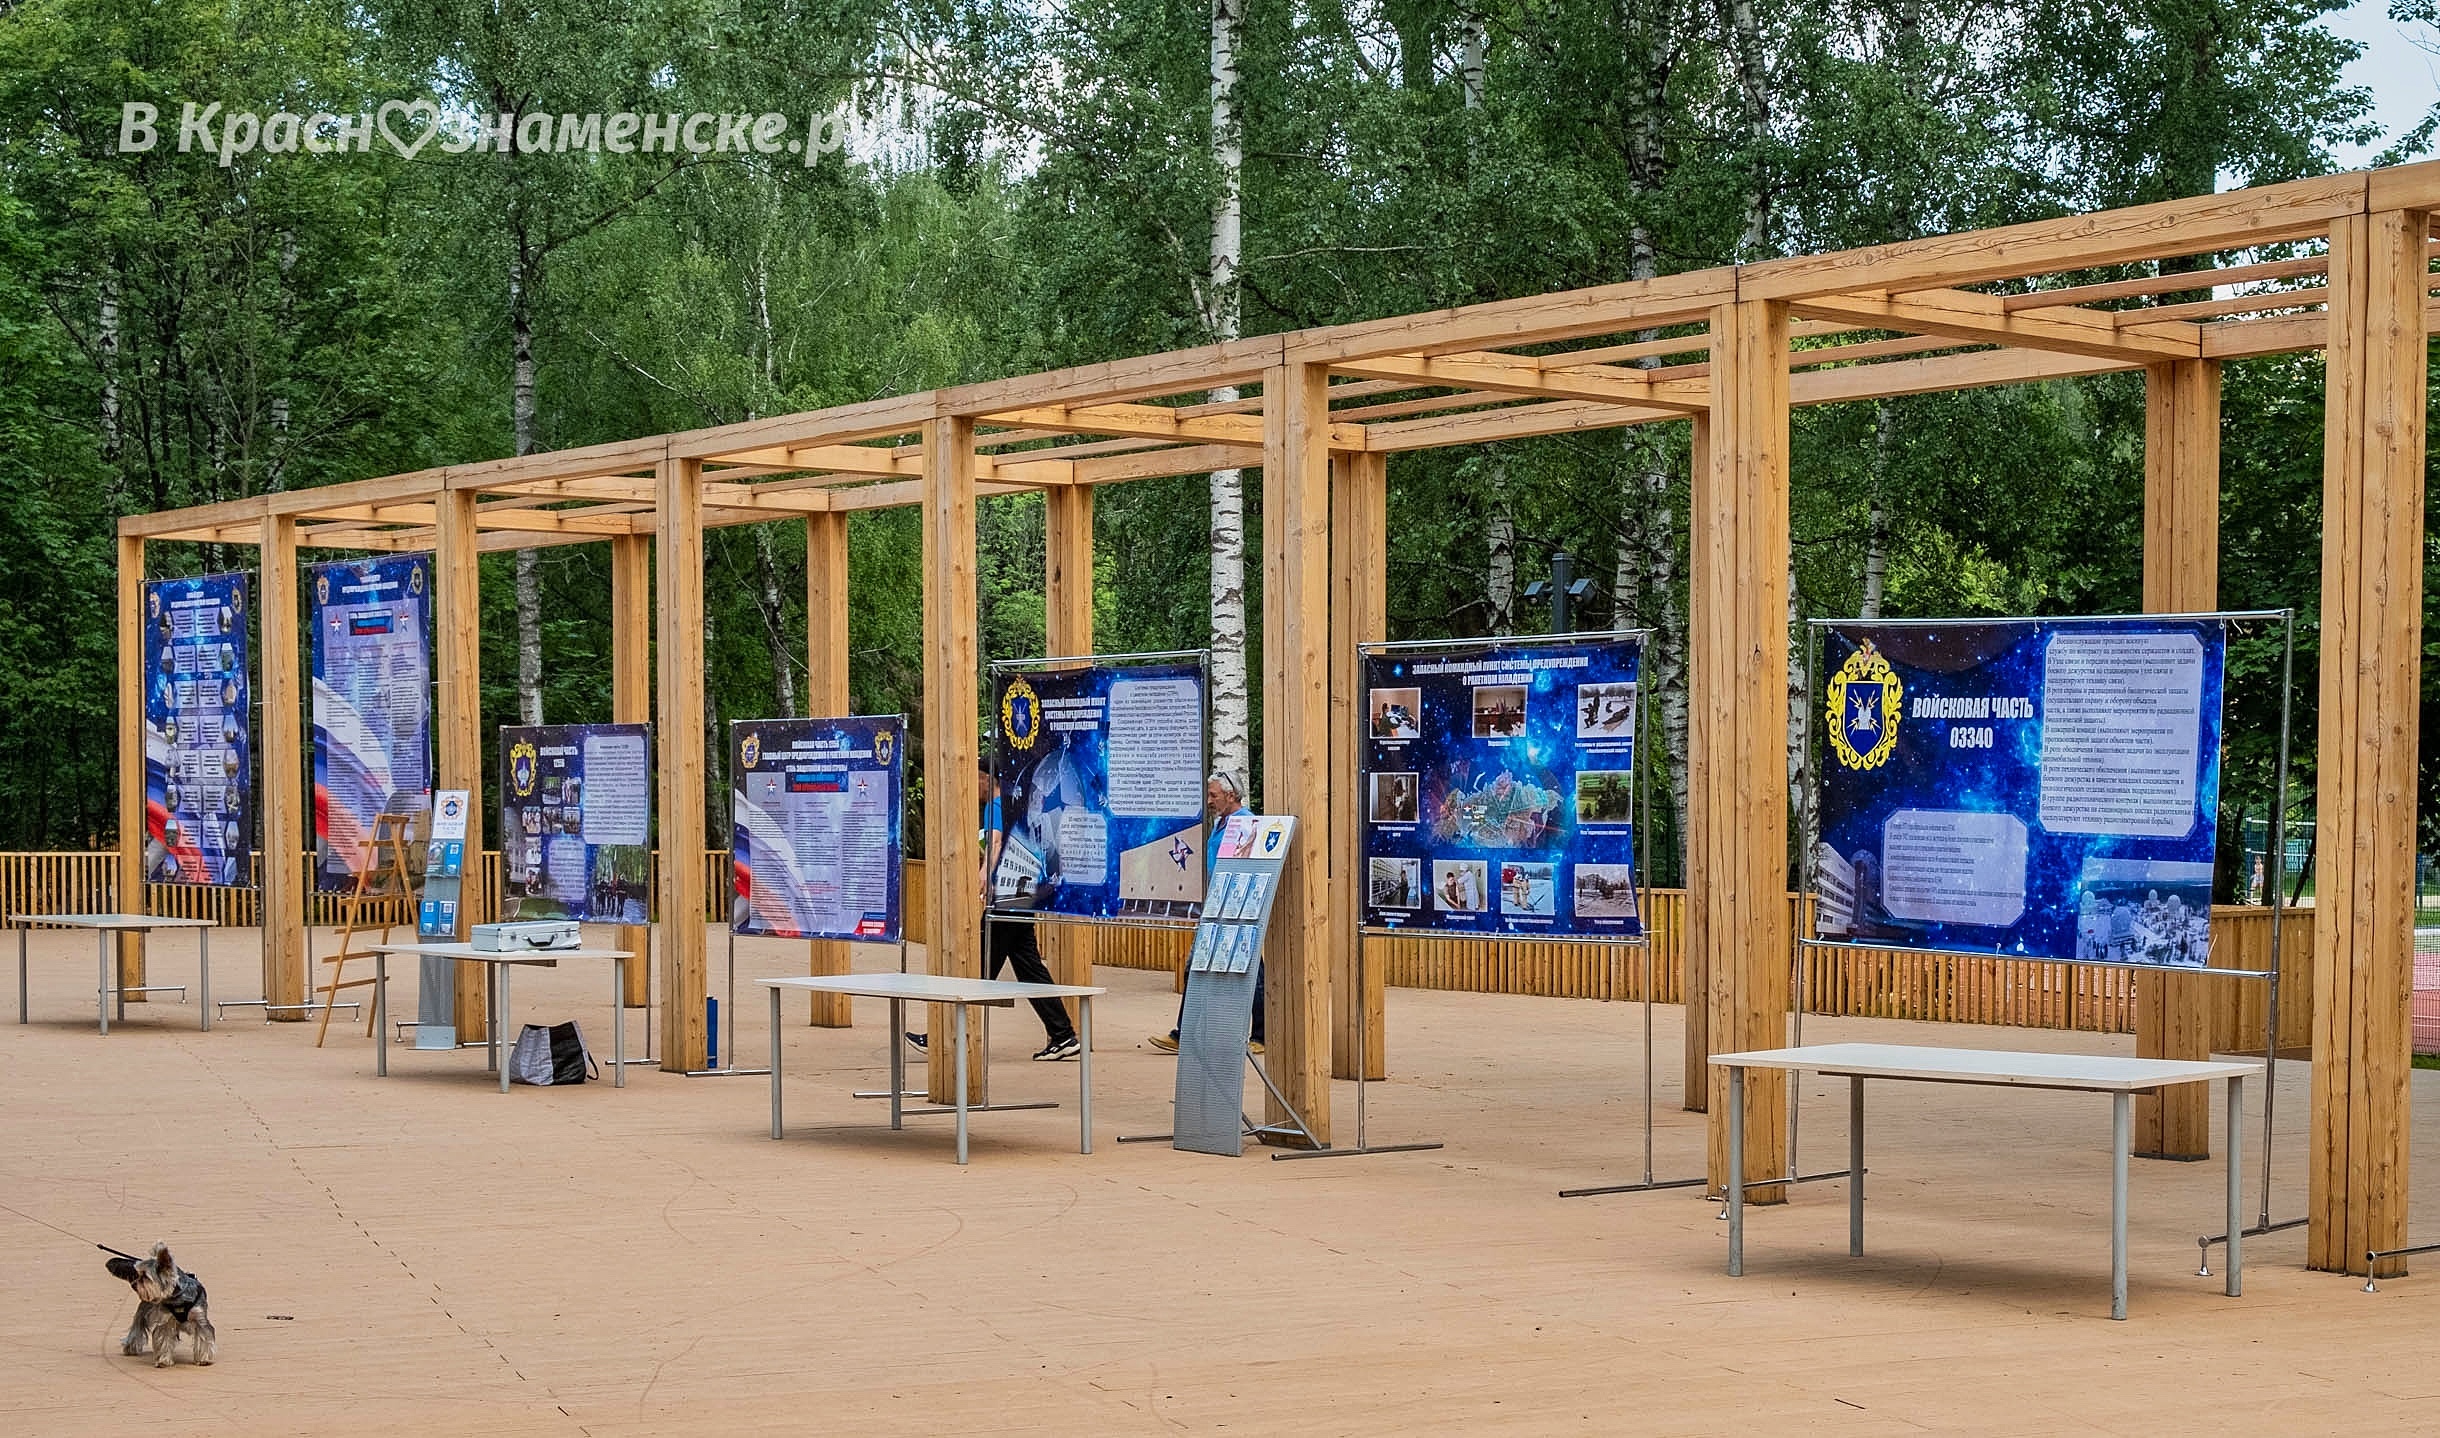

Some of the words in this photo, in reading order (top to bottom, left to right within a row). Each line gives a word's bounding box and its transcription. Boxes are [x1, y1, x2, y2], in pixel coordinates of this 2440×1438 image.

[1911, 692, 1990, 720] ВОЙСКОВАЯ
[1991, 696, 2034, 720] ЧАСТЬ
[1949, 727, 1994, 749] 03340
